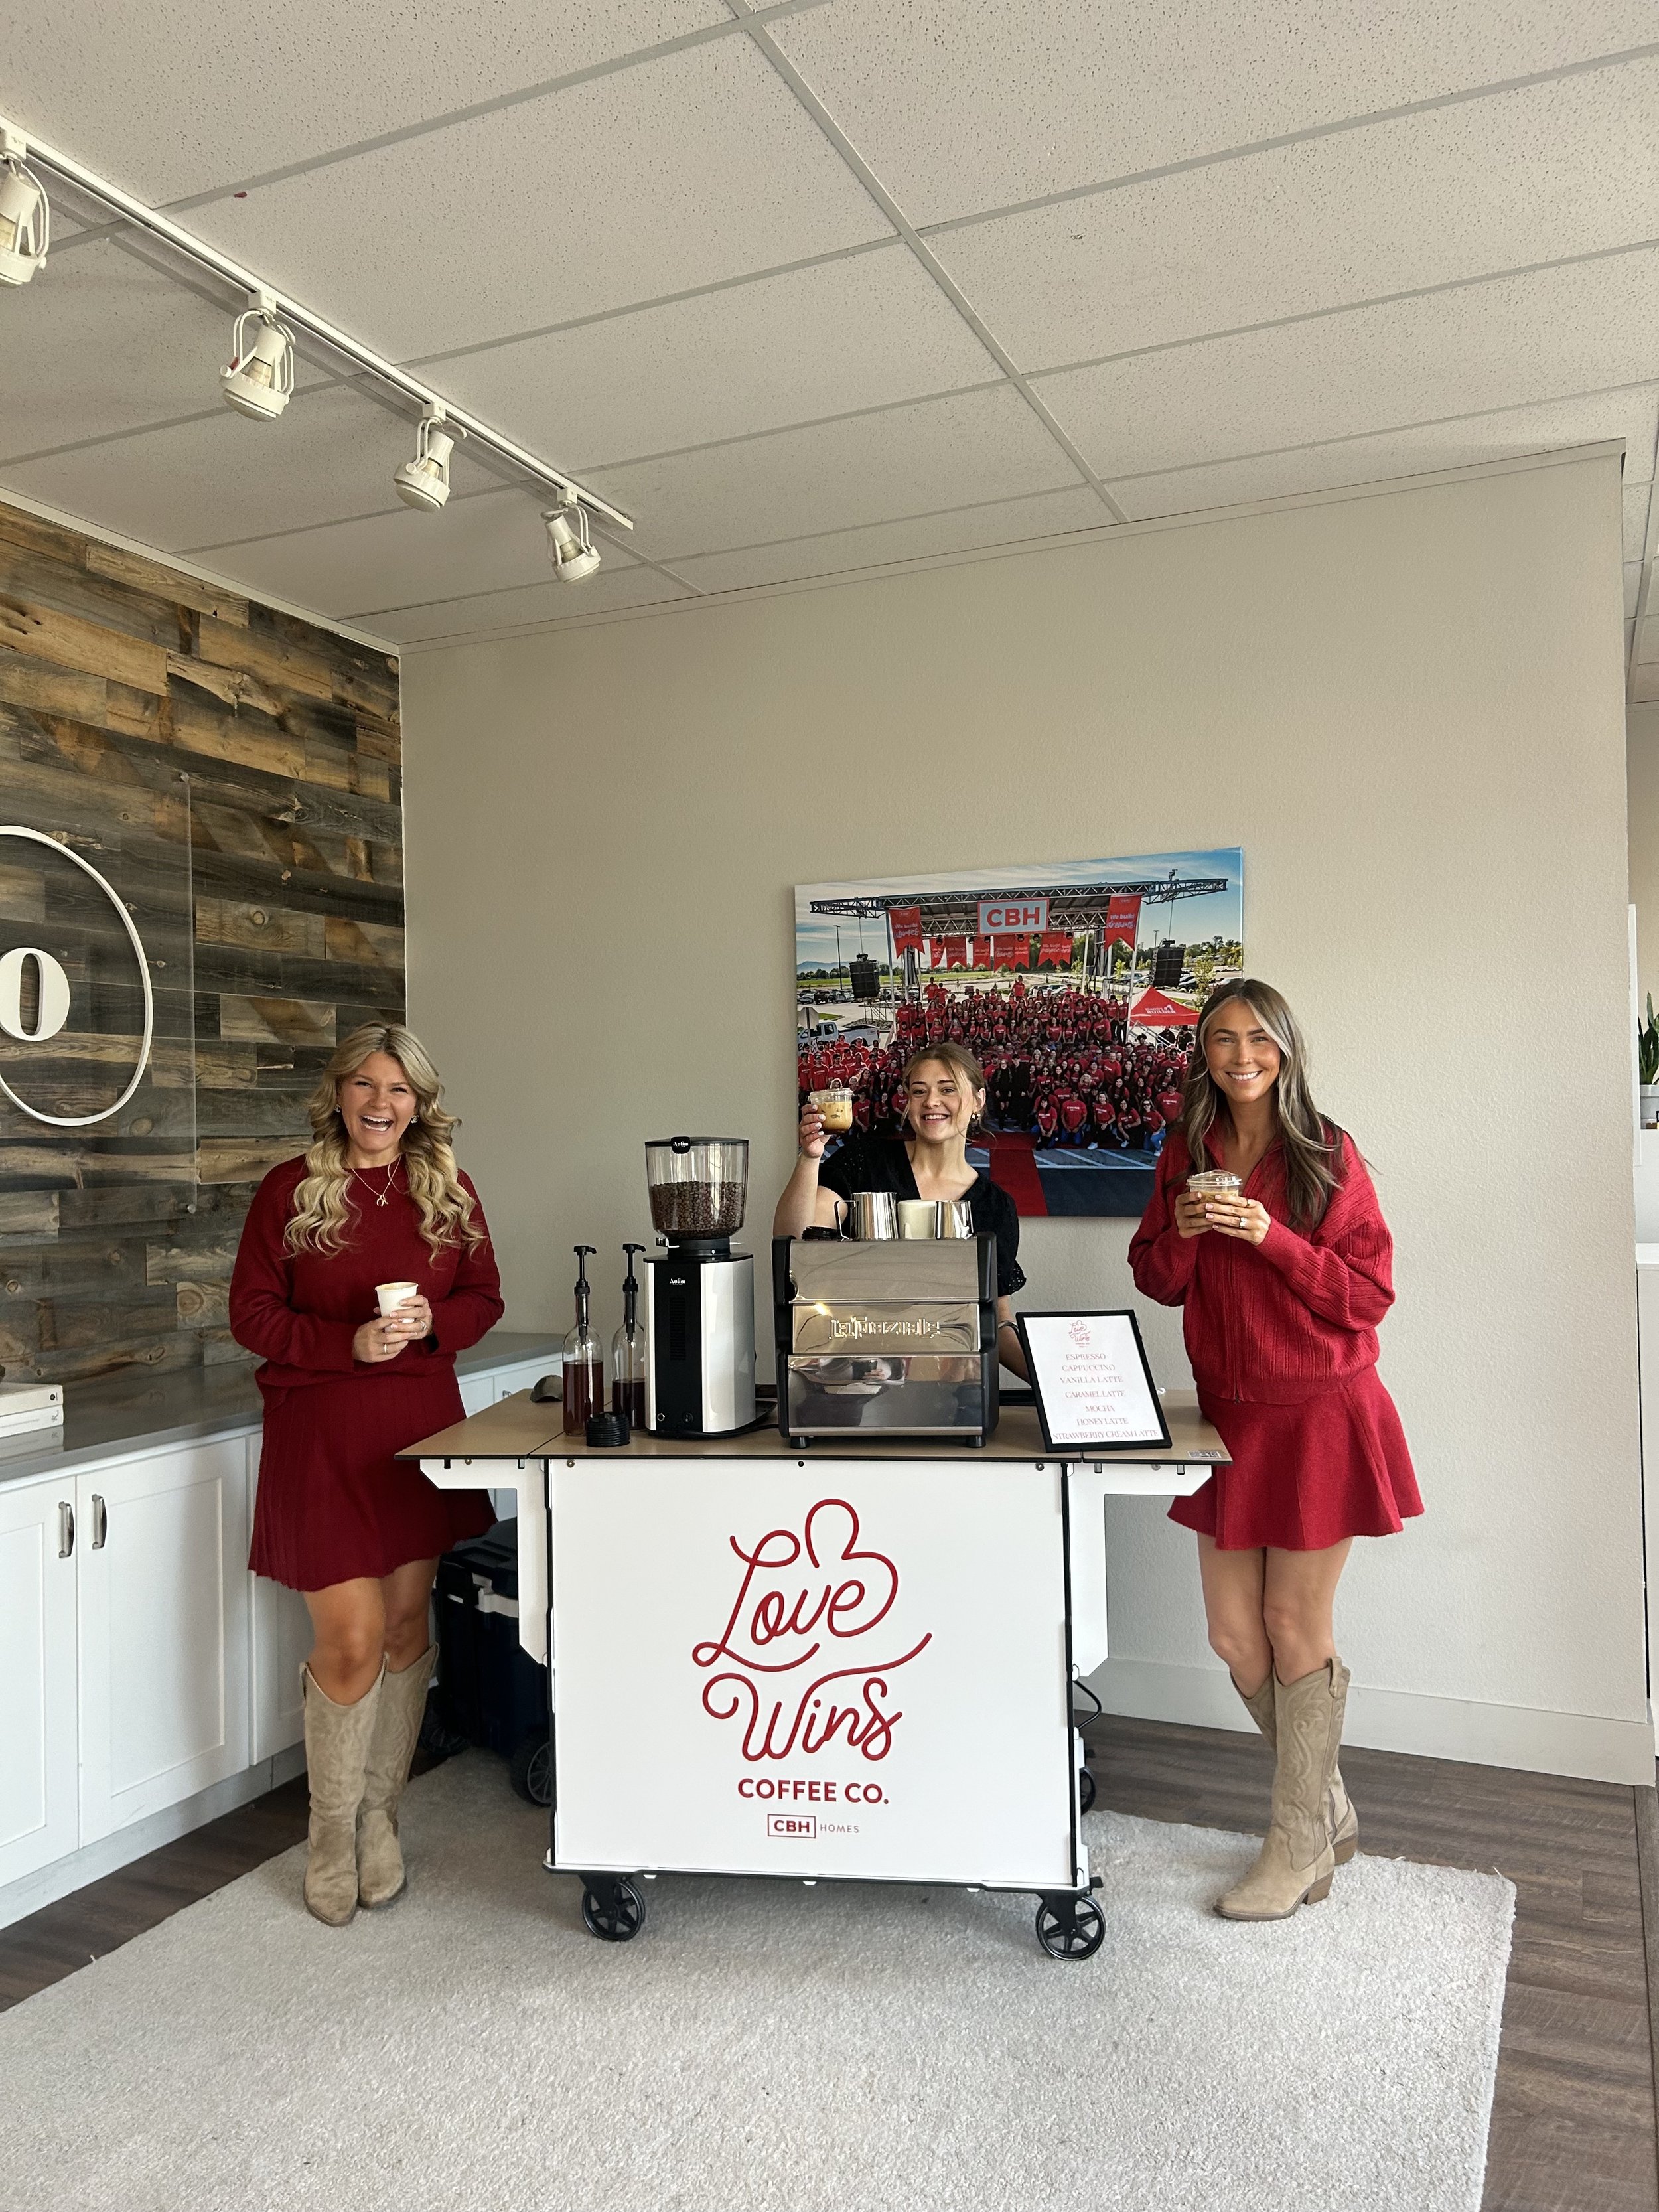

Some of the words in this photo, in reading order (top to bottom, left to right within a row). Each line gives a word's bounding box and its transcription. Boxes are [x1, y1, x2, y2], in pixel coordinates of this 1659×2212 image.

[987, 907, 1041, 928] CBH
[1053, 1432, 1105, 1440] STRAWBERRY
[1134, 1429, 1159, 1438] LATTE
[692, 1498, 899, 1672] Love
[702, 1631, 933, 1762] Wins
[738, 1778, 837, 1802] COFFEE
[845, 1783, 889, 1805] CO.
[774, 1820, 810, 1833] CBH
[820, 1824, 860, 1834] HOMES
